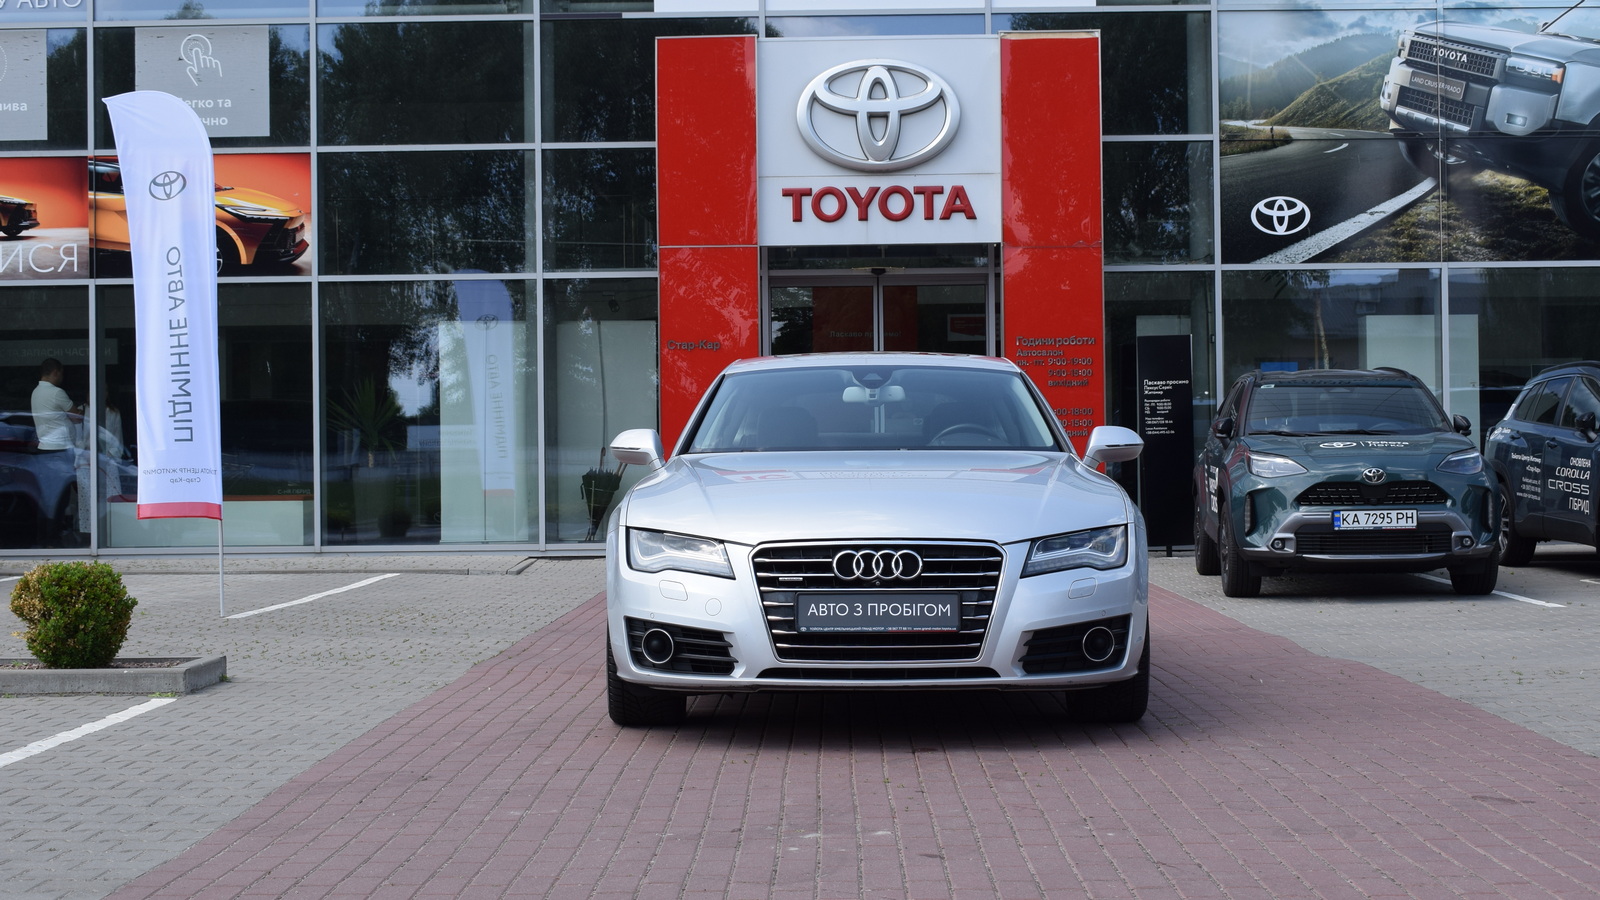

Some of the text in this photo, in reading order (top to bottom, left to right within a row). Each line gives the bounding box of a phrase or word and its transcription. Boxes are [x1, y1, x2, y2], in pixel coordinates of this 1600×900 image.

[1432, 47, 1468, 63] TOYOTA
[1411, 76, 1425, 85] LAND
[0, 102, 28, 111] ива
[181, 98, 232, 108] егко та
[200, 117, 229, 126] чно
[781, 185, 977, 223] TOYOTA
[667, 339, 721, 352] Стар-Кар
[1016, 336, 1096, 348] Години роботи
[1016, 348, 1064, 357] Автосалон
[1047, 379, 1089, 388] вихідний
[1053, 408, 1093, 416] :00-18:00
[1065, 429, 1088, 438] дний
[1555, 466, 1590, 480] COROLLA
[1547, 479, 1590, 495] CROSS
[1341, 511, 1415, 525] KA 7295 PH
[807, 603, 951, 617] АВТО З ПРОБІГОМ
